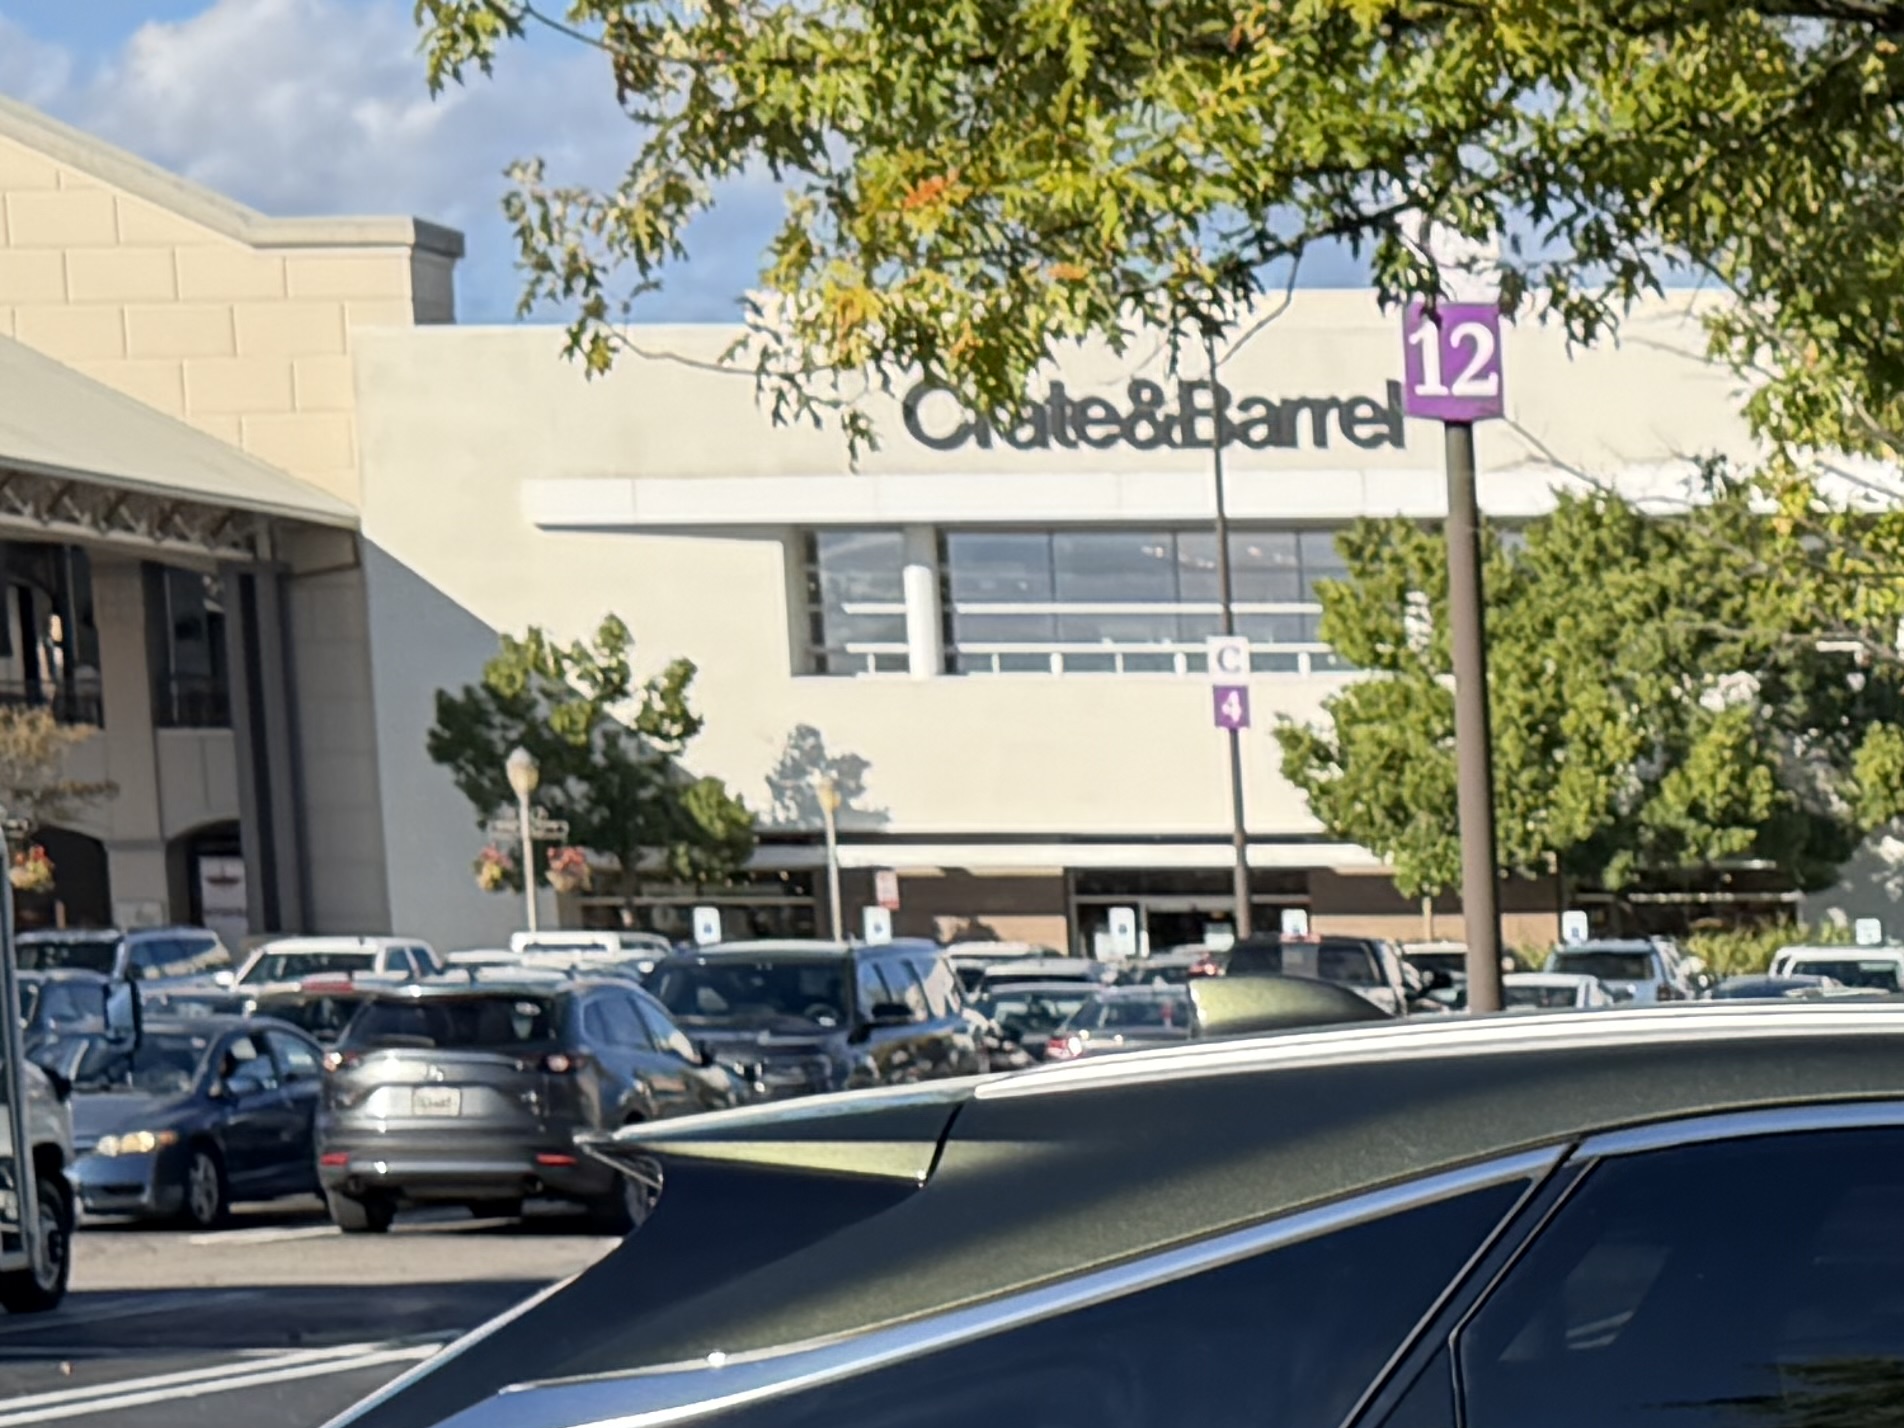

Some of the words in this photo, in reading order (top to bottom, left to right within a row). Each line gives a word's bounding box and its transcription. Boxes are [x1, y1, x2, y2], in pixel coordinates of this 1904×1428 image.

[1408, 317, 1499, 396] 12
[903, 377, 1406, 450] Crate&Barrel
[1216, 645, 1242, 673] C
[1221, 690, 1242, 722] 4
